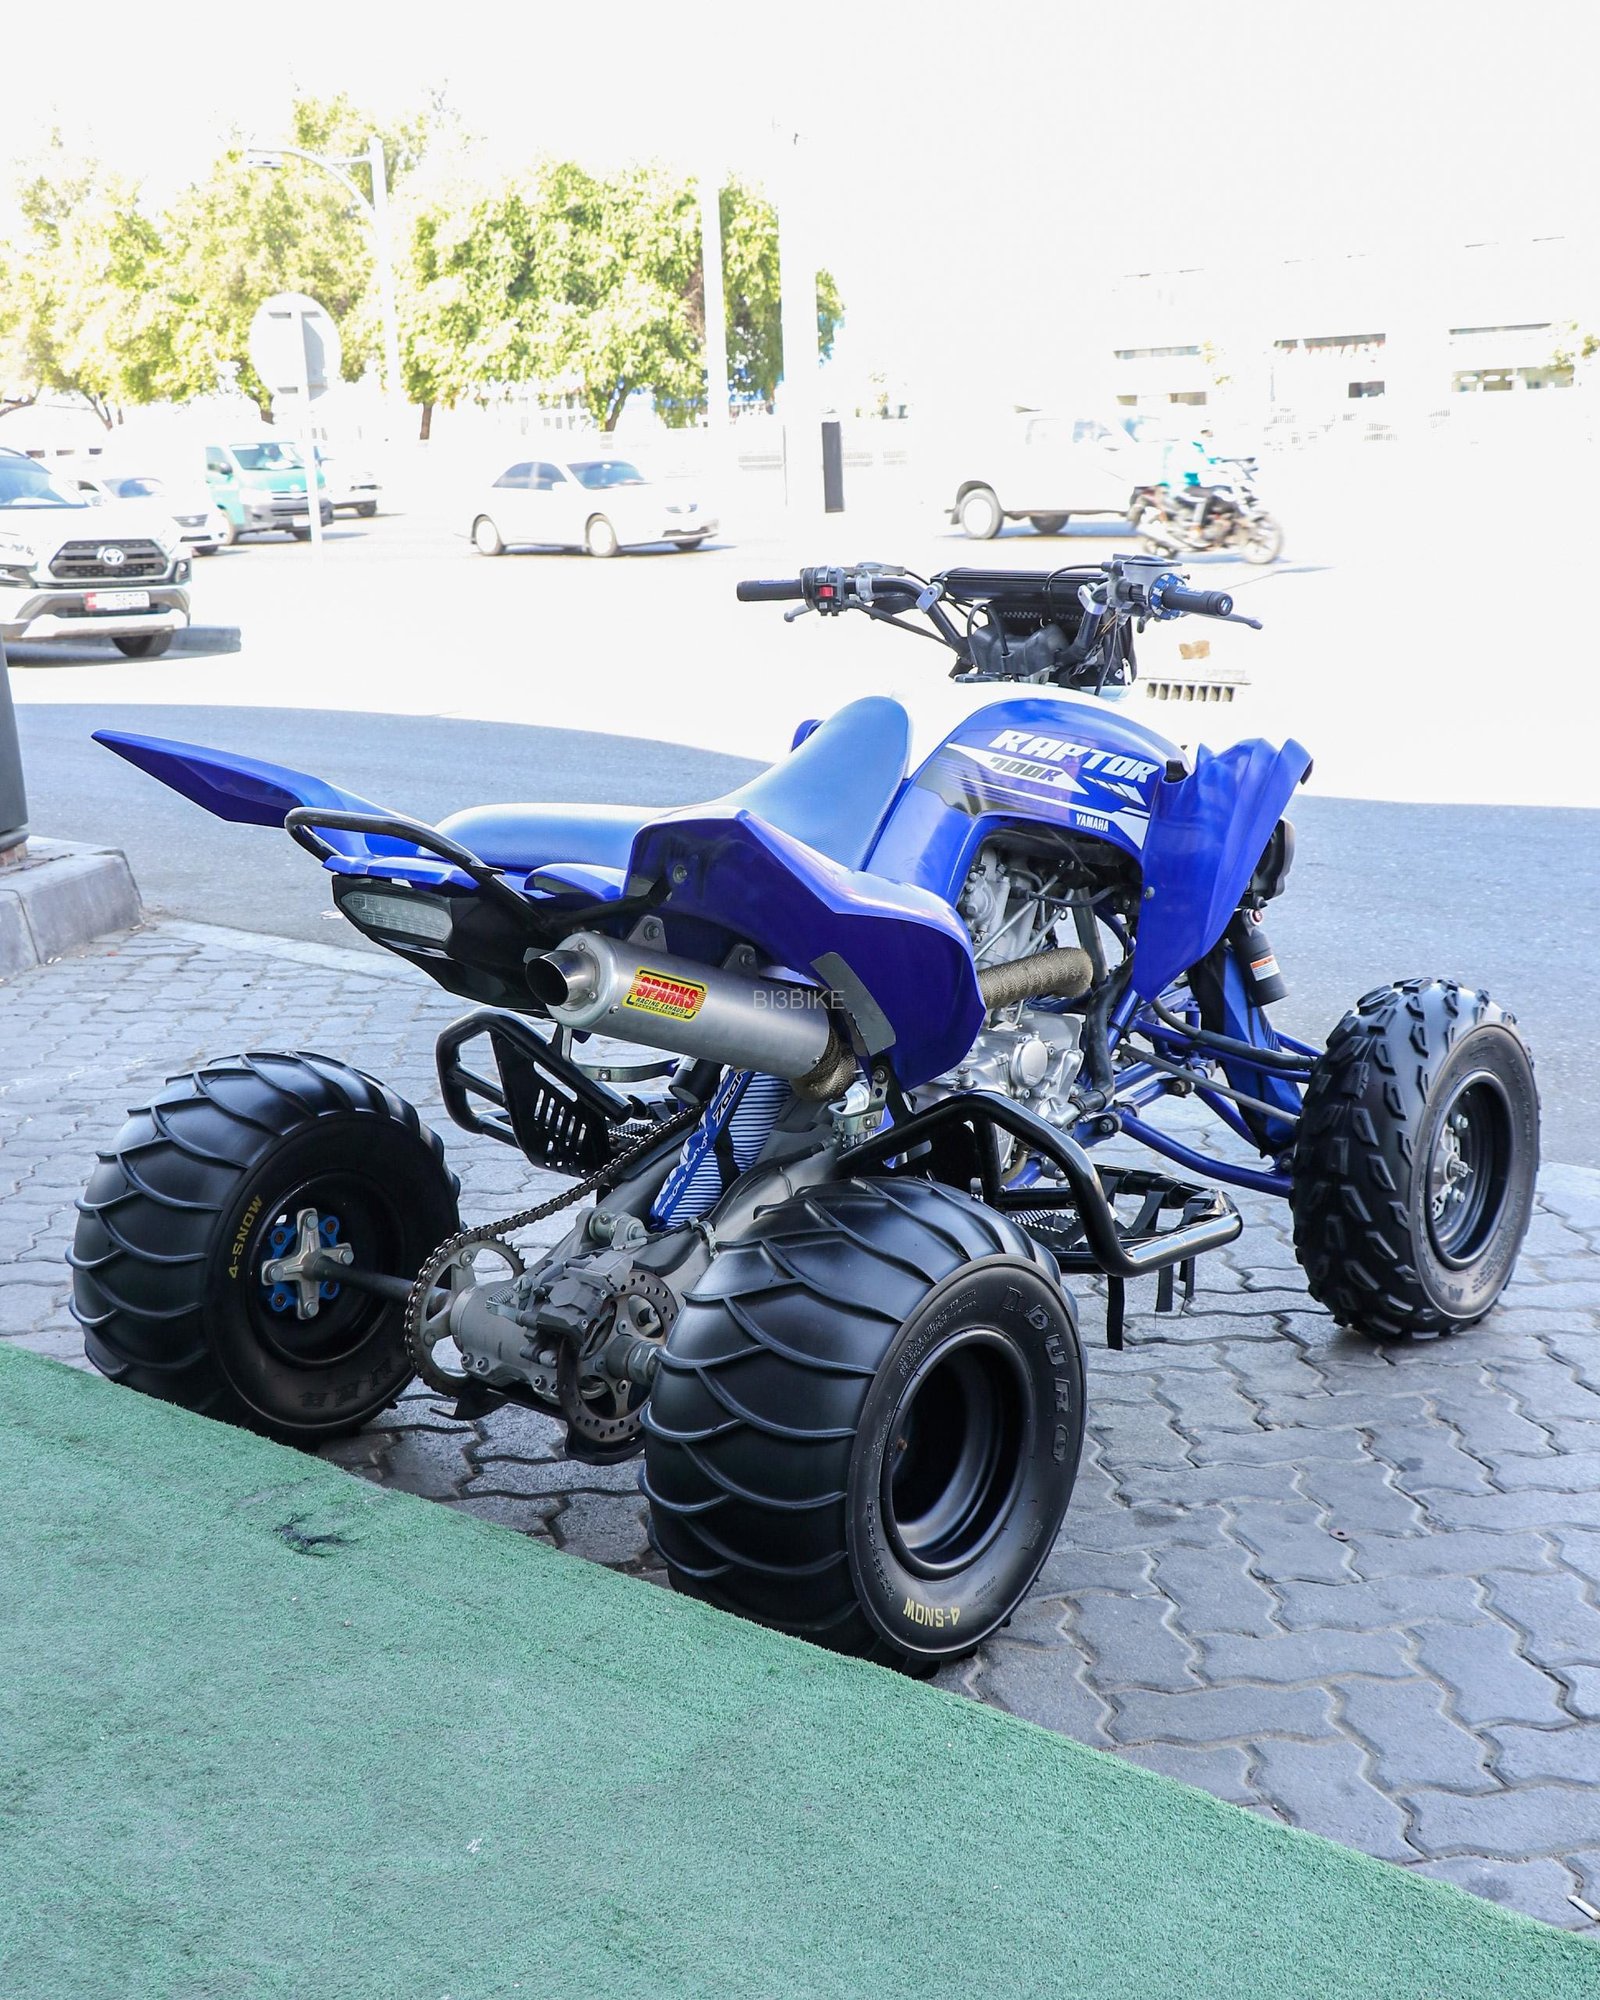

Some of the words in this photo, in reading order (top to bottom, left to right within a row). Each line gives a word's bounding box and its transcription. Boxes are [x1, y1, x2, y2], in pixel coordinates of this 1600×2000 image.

[988, 730, 1160, 783] RAPTOR
[990, 757, 1063, 782] 700R
[1076, 813, 1109, 832] YAMAHA
[636, 977, 698, 1009] SPARKS
[636, 997, 660, 1008] RACING
[661, 1003, 688, 1015] EXHAUST
[228, 1194, 262, 1279] 4-SNOW
[1024, 1304, 1072, 1464] DURO
[903, 1597, 960, 1628] 4-SNOW
